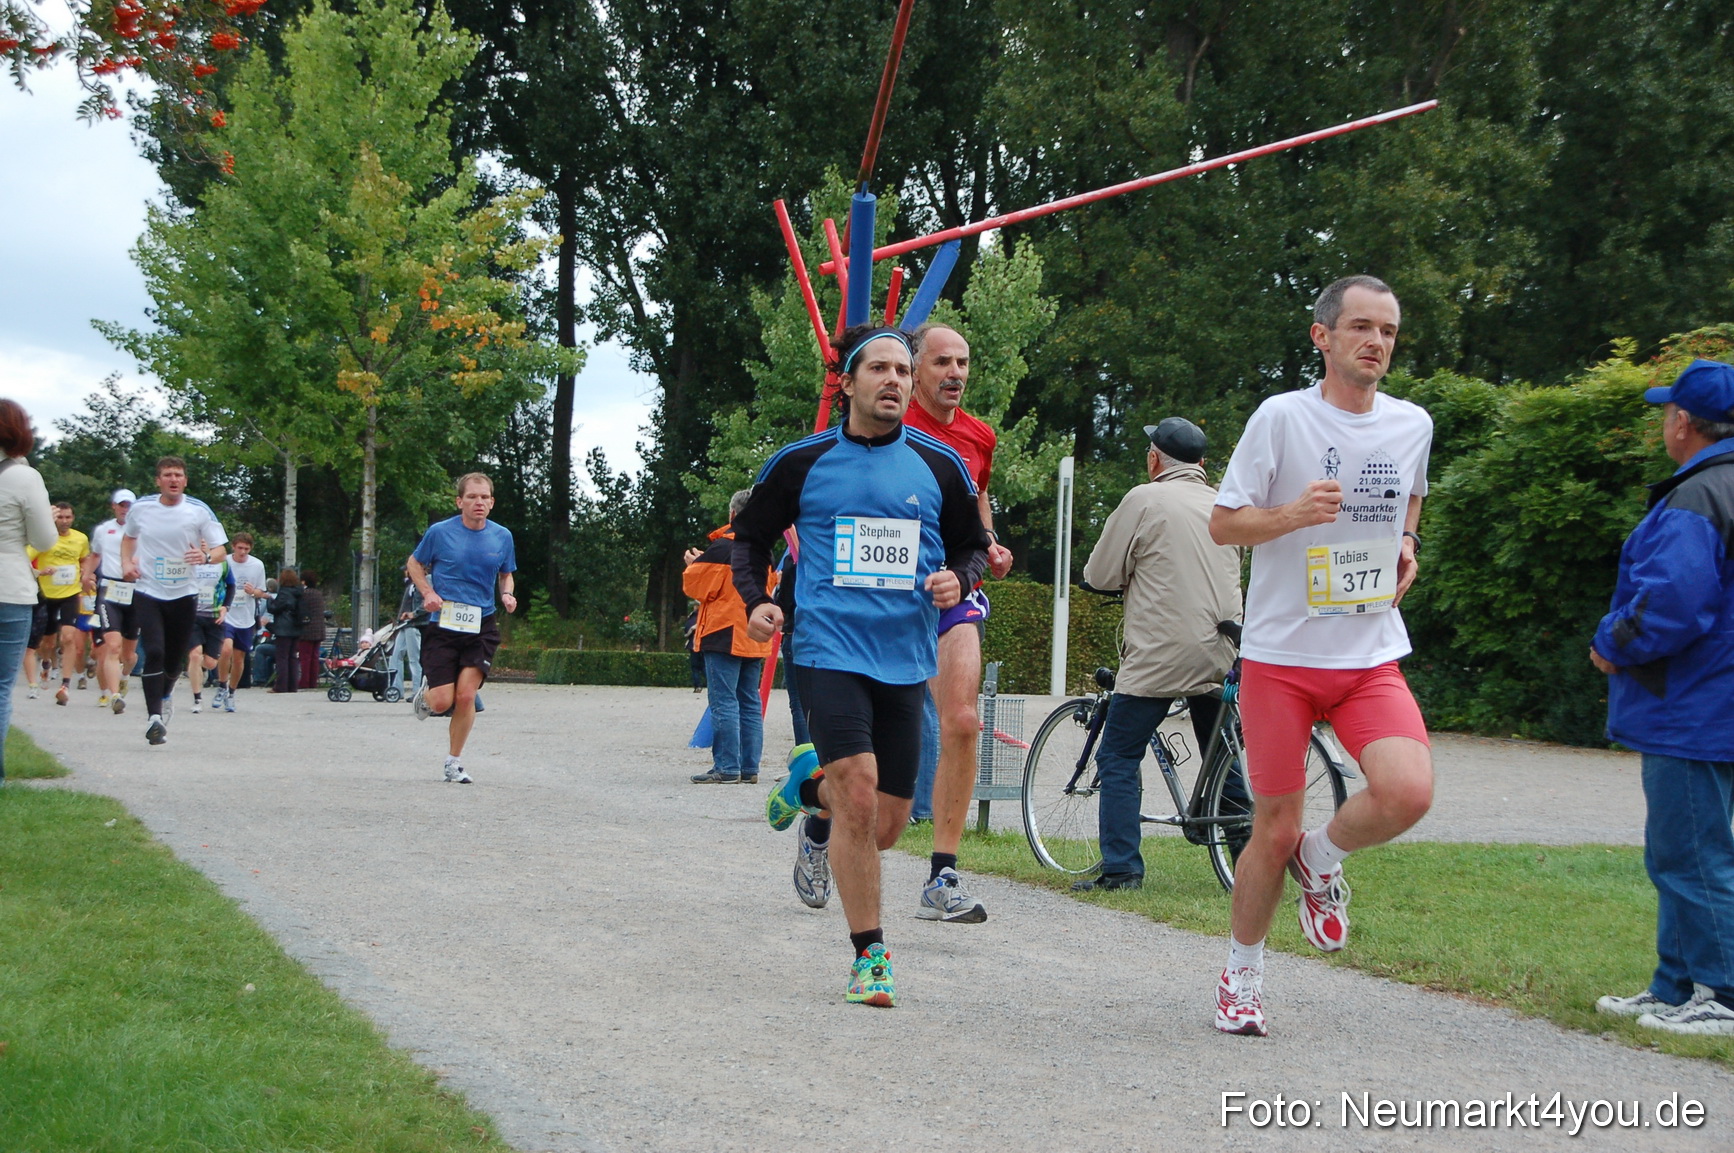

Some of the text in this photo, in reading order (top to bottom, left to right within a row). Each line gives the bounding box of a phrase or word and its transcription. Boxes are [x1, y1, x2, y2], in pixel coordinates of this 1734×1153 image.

[1359, 477, 1400, 486] 21.09.2008
[1339, 501, 1398, 513] Neumarkter
[1352, 513, 1397, 523] Stadtlauf
[860, 524, 901, 539] Stephan
[840, 543, 845, 552] A
[860, 545, 909, 564] 3088
[1333, 550, 1369, 565] Tobias
[166, 567, 187, 575] 3087
[1313, 576, 1319, 586] A
[1343, 568, 1381, 592] 377
[455, 612, 475, 622] 902
